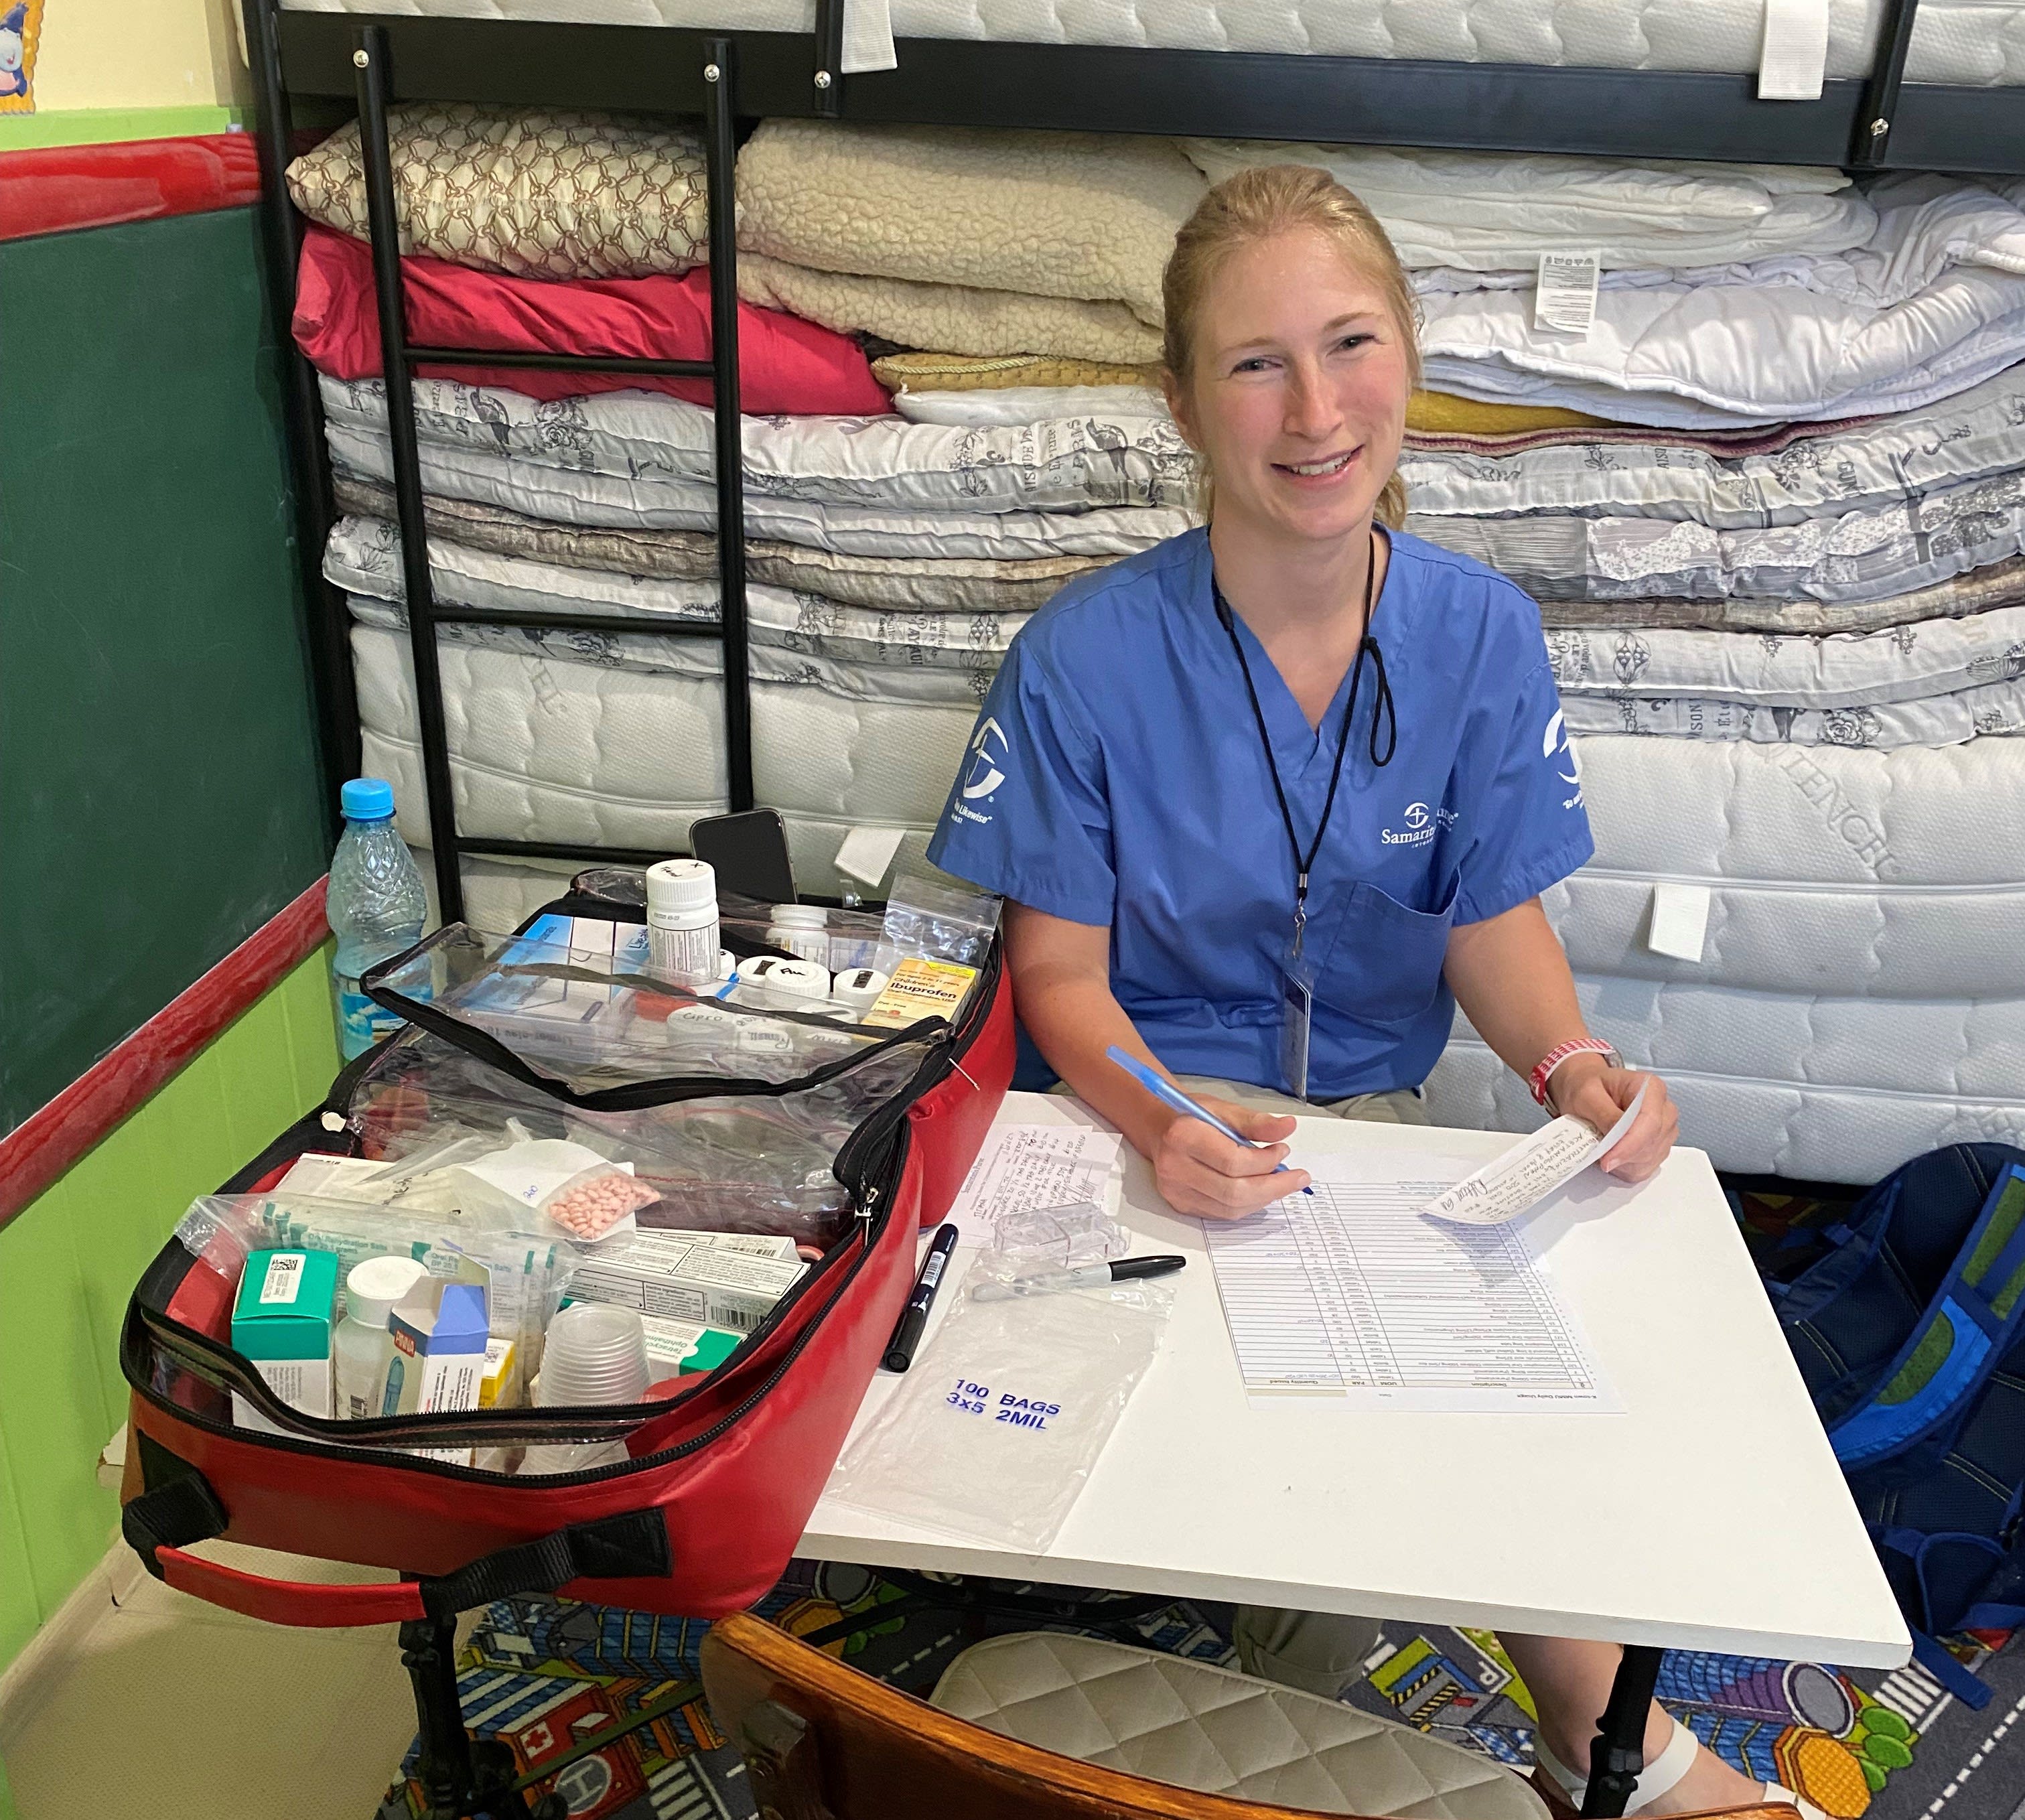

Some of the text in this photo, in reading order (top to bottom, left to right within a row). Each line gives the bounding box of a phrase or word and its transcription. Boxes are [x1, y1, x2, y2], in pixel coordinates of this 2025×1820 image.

[890, 982, 957, 999] Ibuprofen
[946, 1392, 1047, 1429] 3x5 2MIL
[956, 1379, 1061, 1415] 100 BAGS
